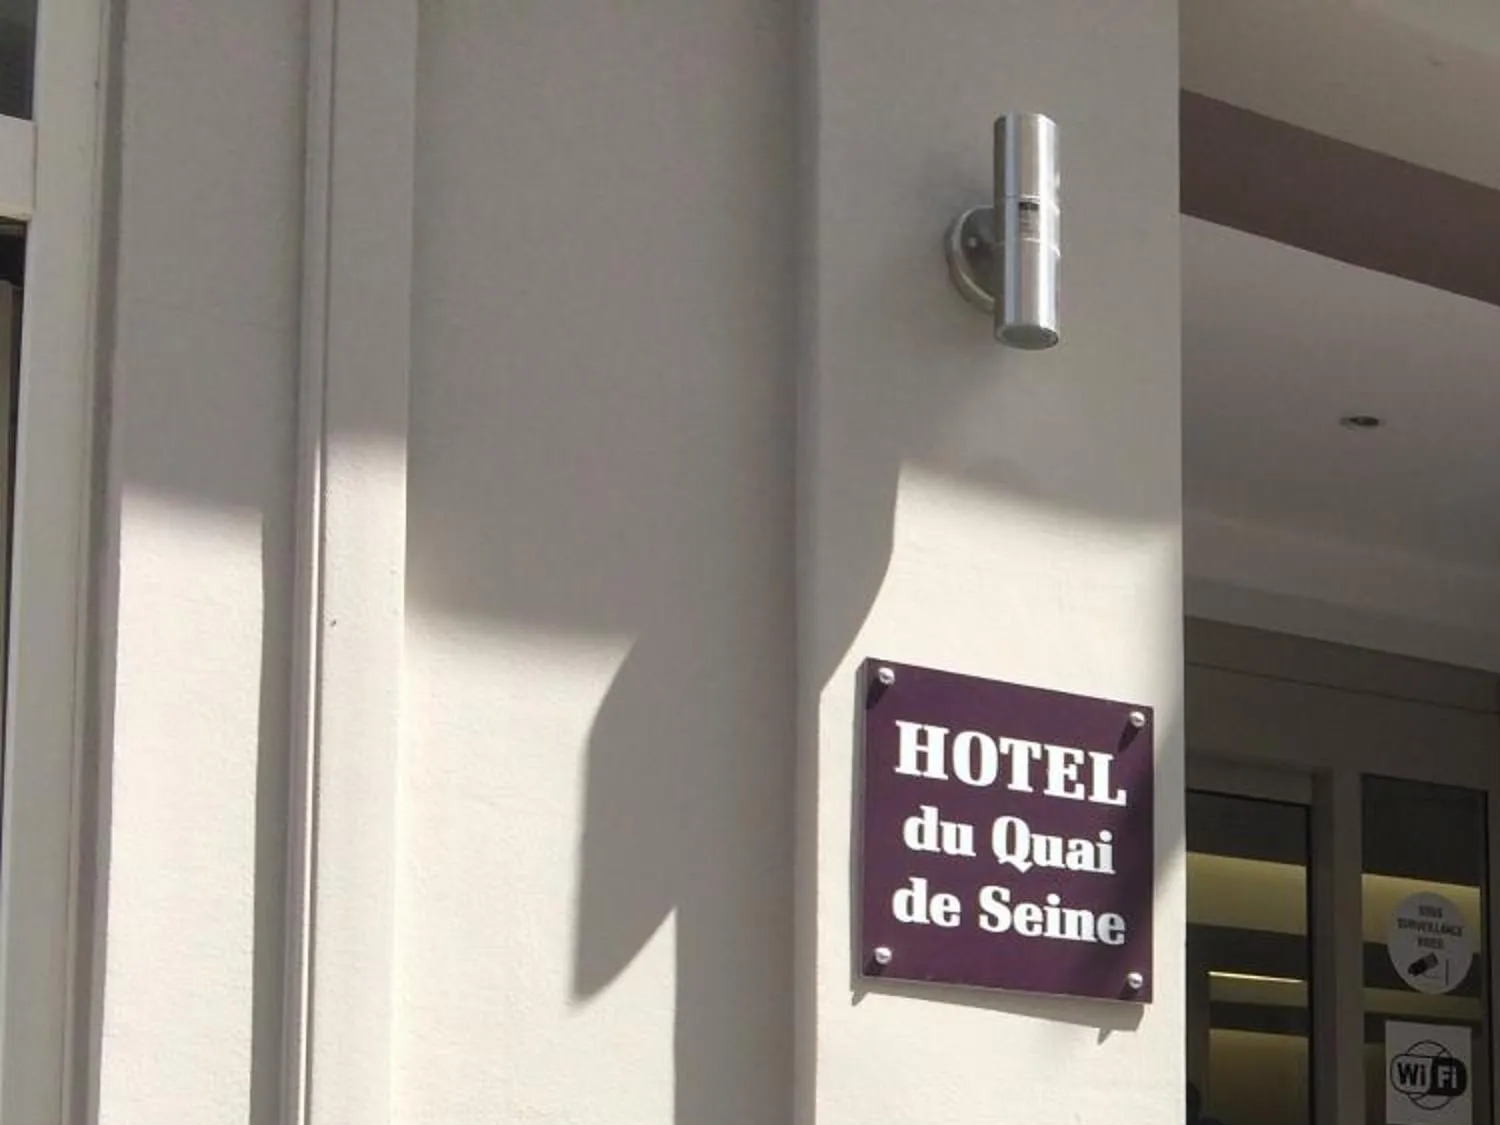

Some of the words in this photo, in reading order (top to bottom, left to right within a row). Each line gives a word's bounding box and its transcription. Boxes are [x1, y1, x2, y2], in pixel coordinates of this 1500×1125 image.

[894, 719, 1127, 807] HOTEL
[903, 805, 977, 857] du
[991, 815, 1117, 874] Quai
[892, 876, 962, 928] de
[978, 885, 1127, 946] Seine
